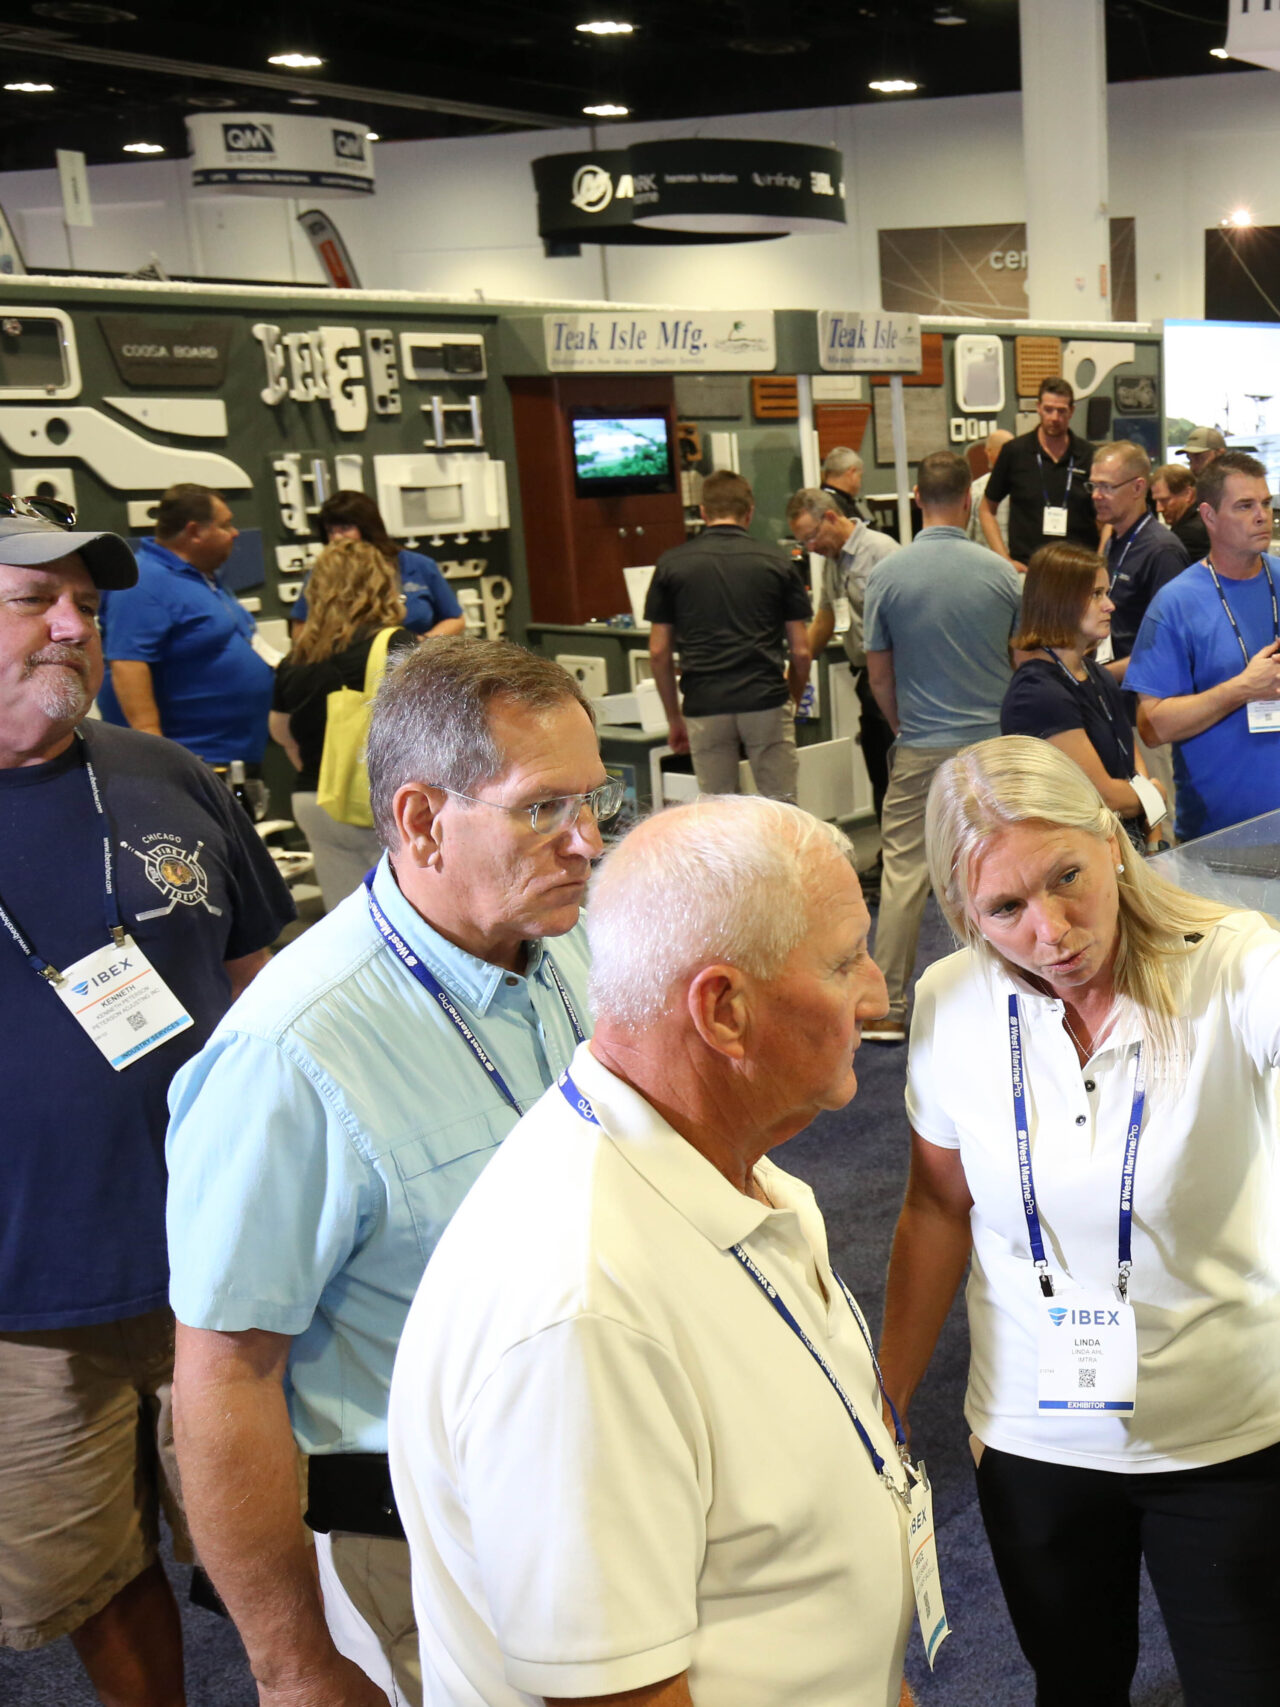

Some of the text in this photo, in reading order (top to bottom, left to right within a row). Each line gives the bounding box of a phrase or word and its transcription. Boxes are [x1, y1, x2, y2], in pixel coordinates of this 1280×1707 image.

[227, 128, 266, 149] QM
[553, 320, 707, 356] Teak Isle Mfg.
[829, 318, 899, 350] Teak Isle
[122, 344, 219, 359] COOSA BOARD
[141, 833, 182, 845] CHICAGO
[157, 848, 179, 857] FIRE
[386, 931, 412, 960] West
[91, 957, 133, 987] IBEX
[101, 984, 136, 1008] KENNETH
[120, 1036, 151, 1060] INDUSTRY
[150, 1020, 180, 1042] SERVICES
[1009, 1025, 1019, 1048] West
[470, 1036, 488, 1064] West
[1017, 1138, 1029, 1162] West
[1122, 1176, 1133, 1201] West
[748, 1257, 769, 1289] West
[1071, 1309, 1120, 1326] IBEX
[1074, 1339, 1101, 1347] LINDA
